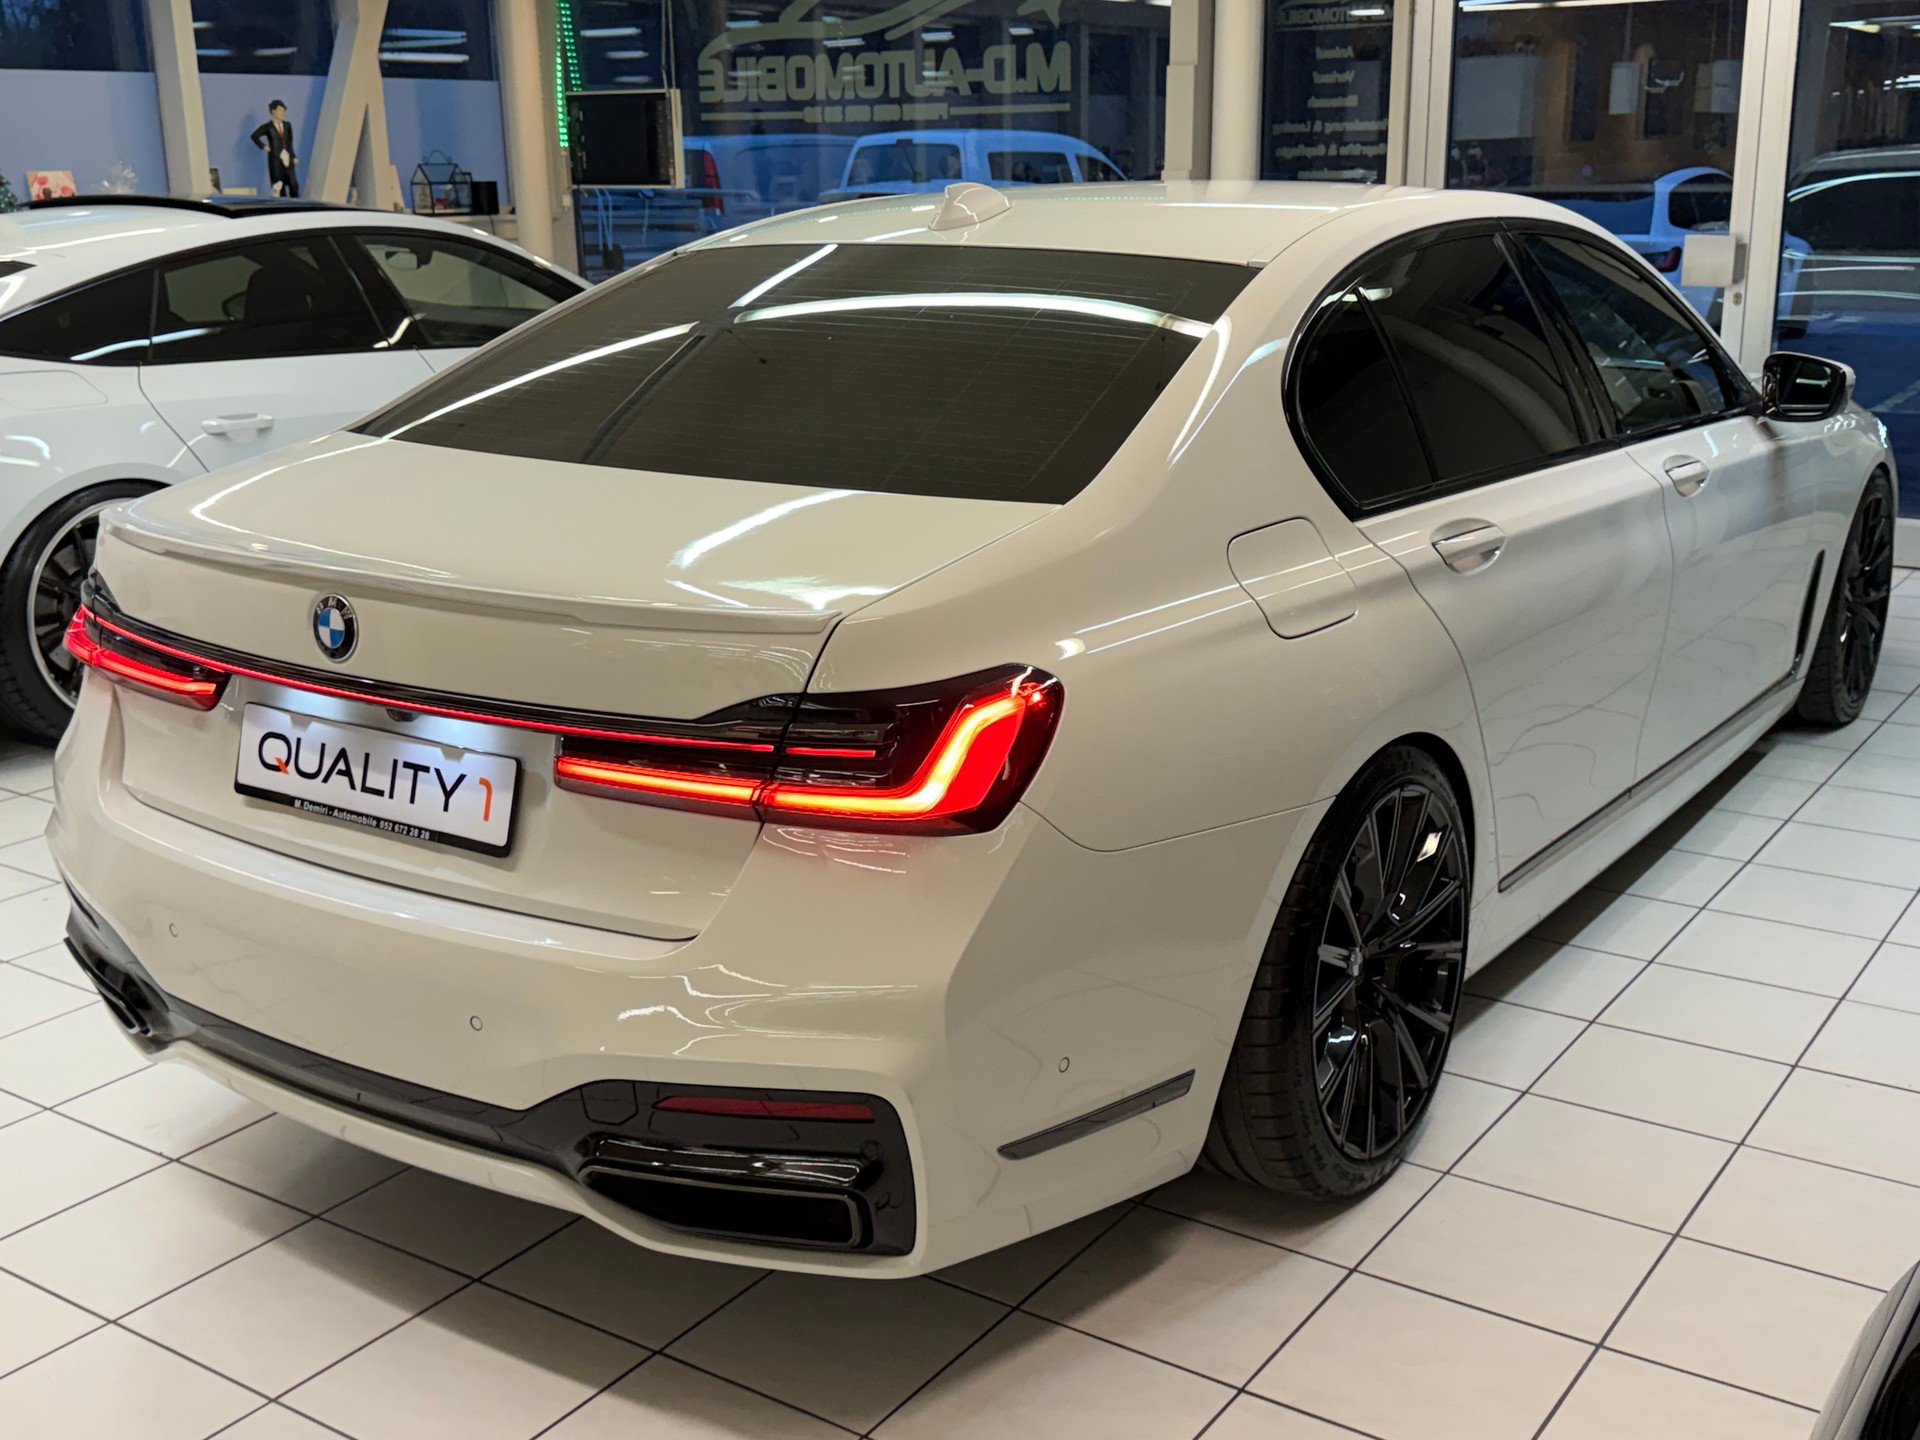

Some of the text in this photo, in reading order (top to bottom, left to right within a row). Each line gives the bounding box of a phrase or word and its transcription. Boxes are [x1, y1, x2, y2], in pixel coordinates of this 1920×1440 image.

[258, 731, 467, 812] QUALITY
[303, 802, 328, 815] Demiri
[333, 809, 378, 827] Automobile
[379, 820, 393, 831] 052
[394, 824, 408, 835] 672
